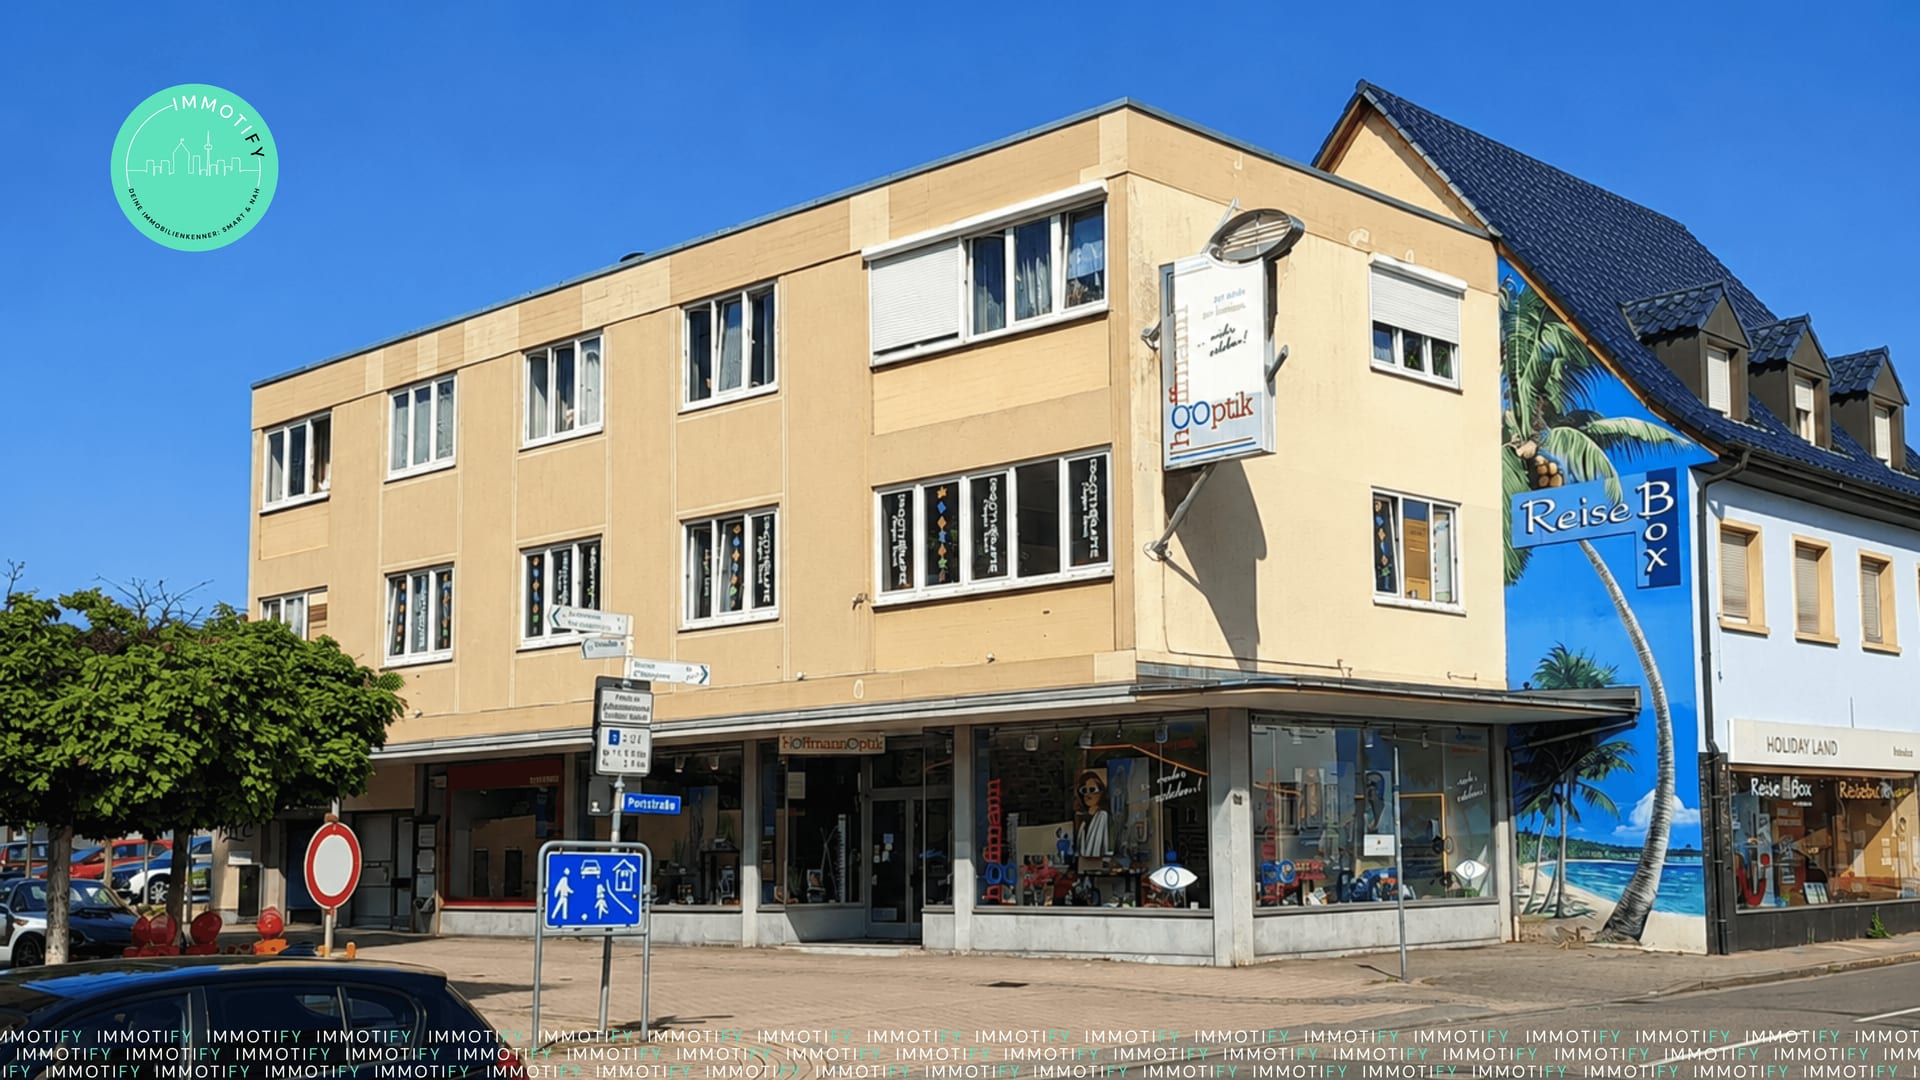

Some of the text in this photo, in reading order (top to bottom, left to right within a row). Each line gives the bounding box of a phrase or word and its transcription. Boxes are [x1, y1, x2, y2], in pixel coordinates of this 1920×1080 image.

[1520, 481, 1675, 573] Reise Box
[1766, 736, 1839, 756] HOLIDAY LAND
[1791, 779, 1812, 798] Box
